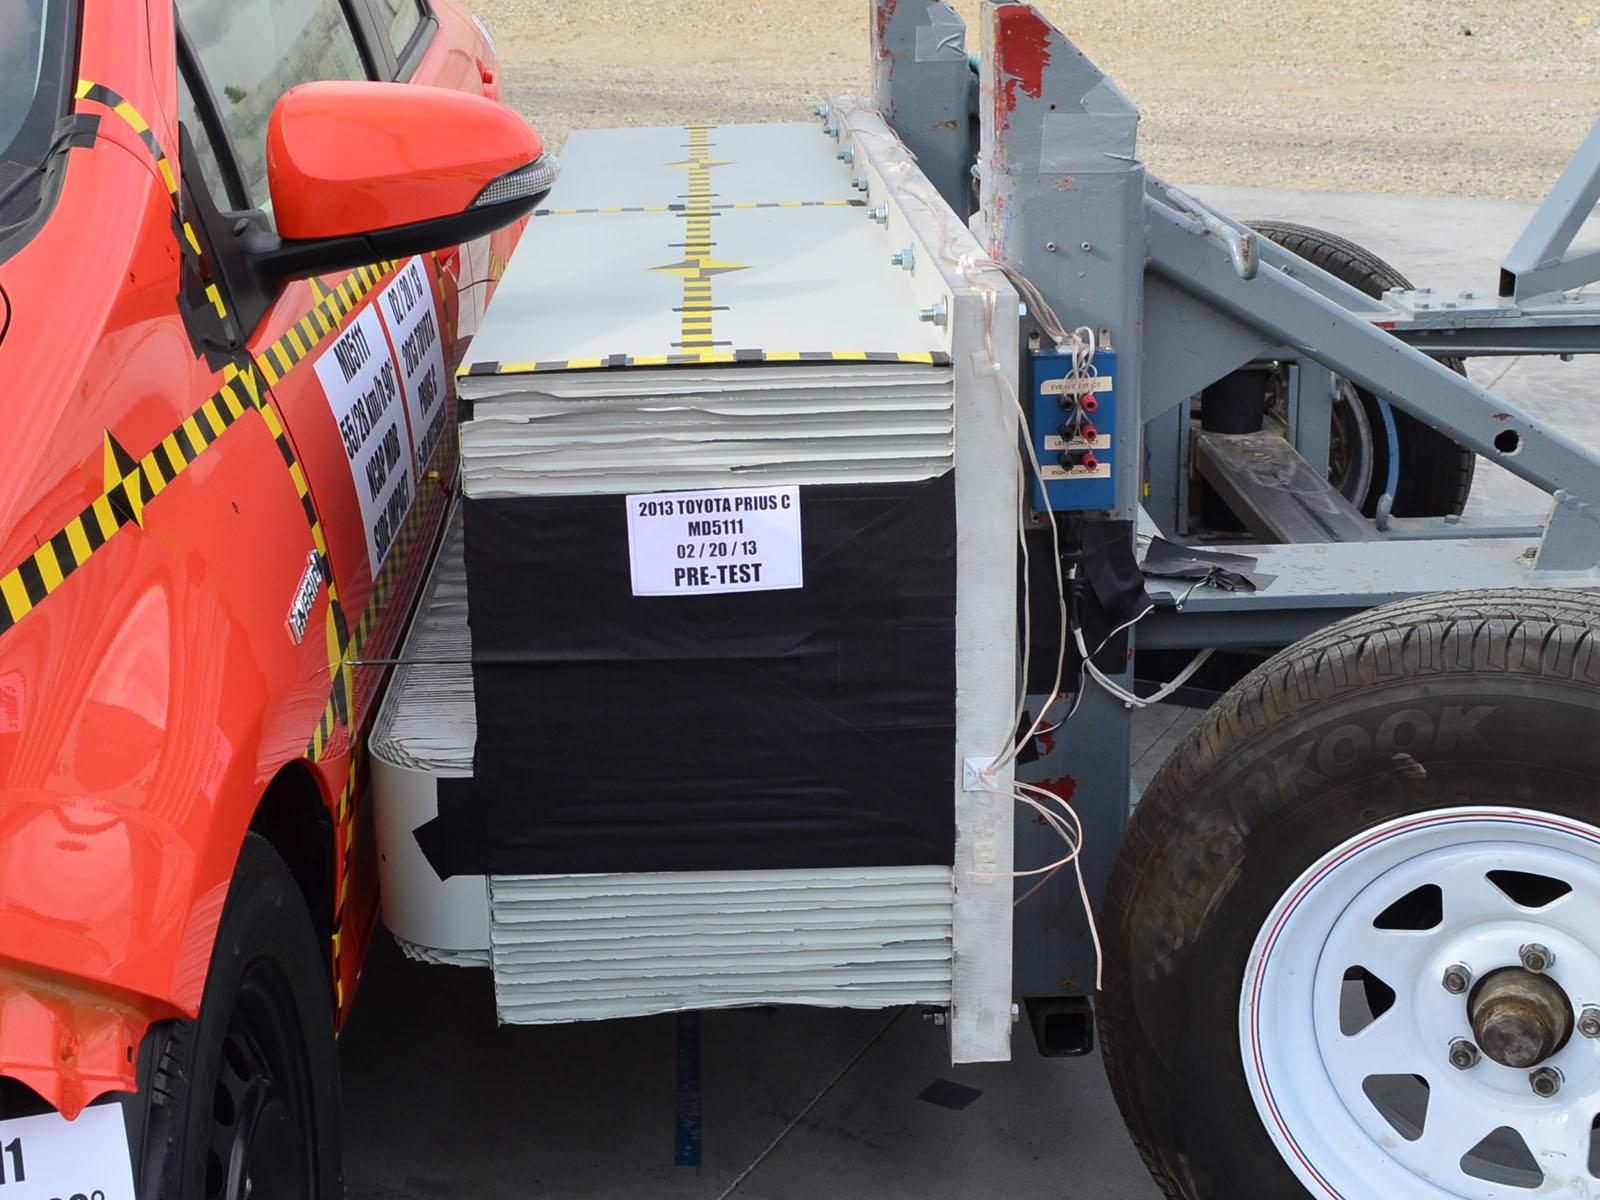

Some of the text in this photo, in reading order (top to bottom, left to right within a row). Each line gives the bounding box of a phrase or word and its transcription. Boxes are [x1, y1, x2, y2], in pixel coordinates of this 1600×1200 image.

[388, 287, 404, 325] 02
[399, 275, 414, 312] 20
[333, 321, 371, 384] MD5111
[339, 398, 371, 460] 55/28
[362, 375, 388, 430] km/h
[366, 422, 401, 503] NCAP MDB
[639, 494, 790, 516] 2013 TOYOTA PRIUS C
[688, 519, 744, 537] MD5111
[677, 540, 757, 559] 02 / 20 / 13
[674, 563, 762, 587] PRE-TEST
